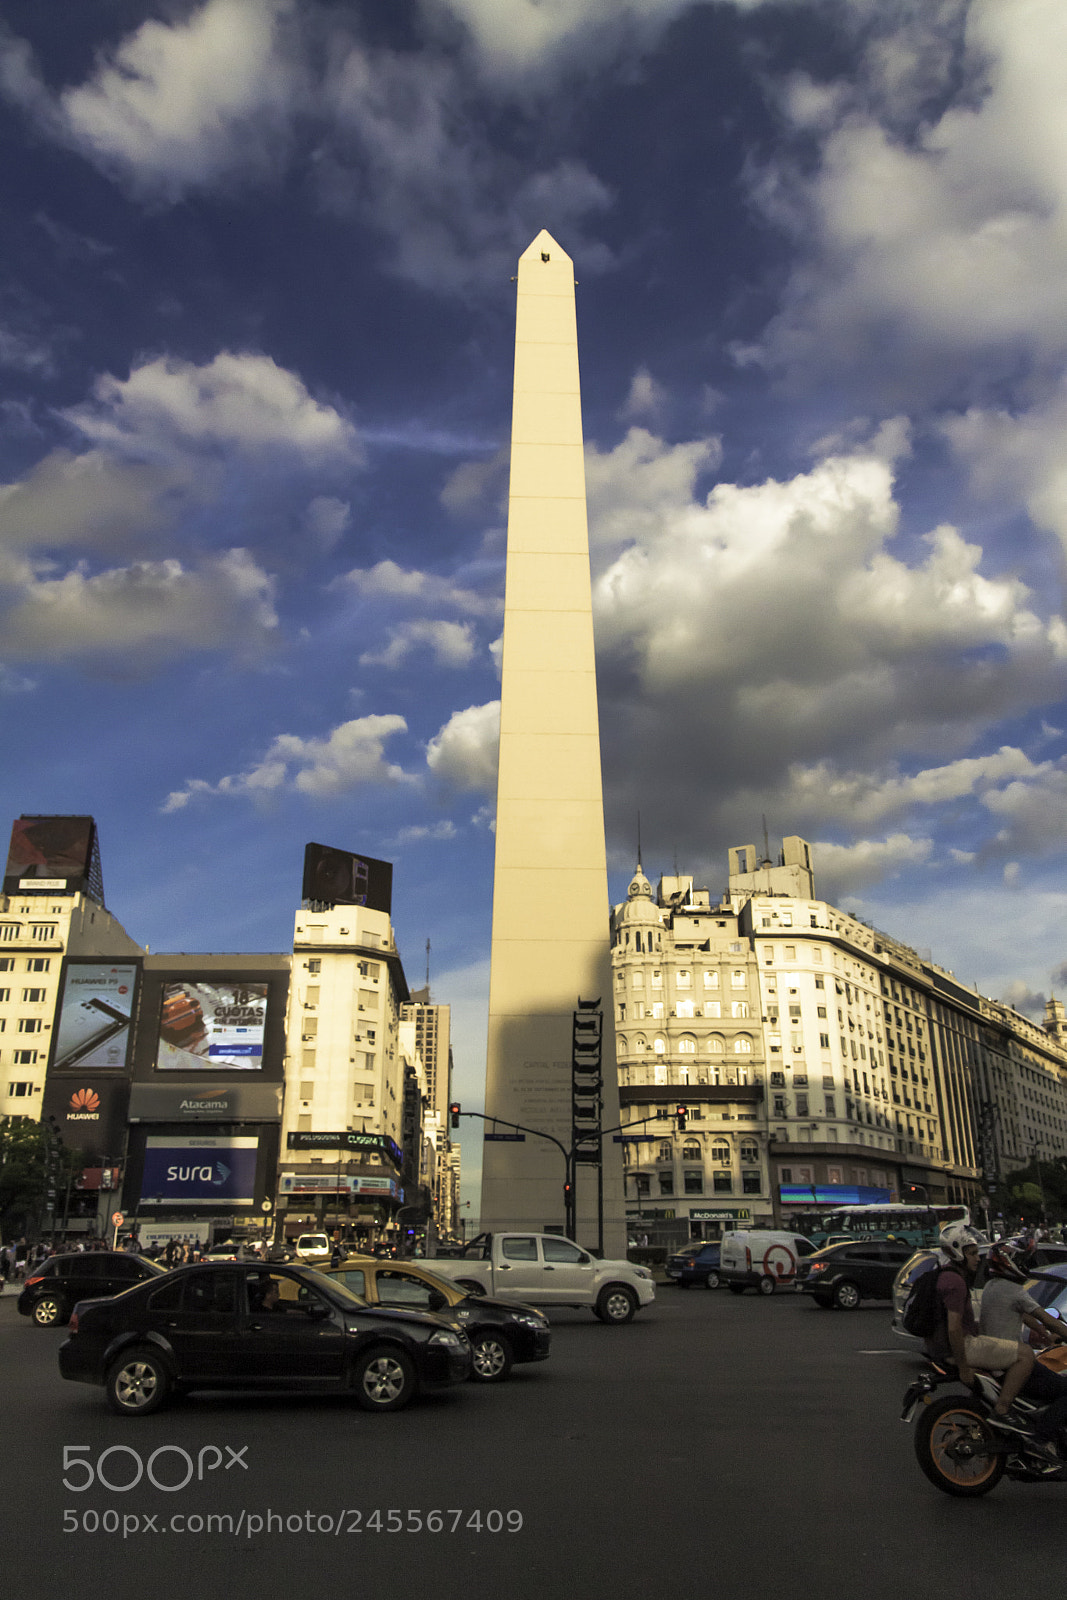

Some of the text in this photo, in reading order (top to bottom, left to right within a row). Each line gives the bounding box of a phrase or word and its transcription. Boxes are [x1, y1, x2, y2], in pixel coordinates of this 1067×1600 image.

[232, 990, 249, 1005] 18
[214, 1006, 263, 1017] CUOTAS
[179, 1099, 228, 1109] Atacama
[166, 1165, 213, 1182] sura
[693, 1211, 734, 1220] McDonald's
